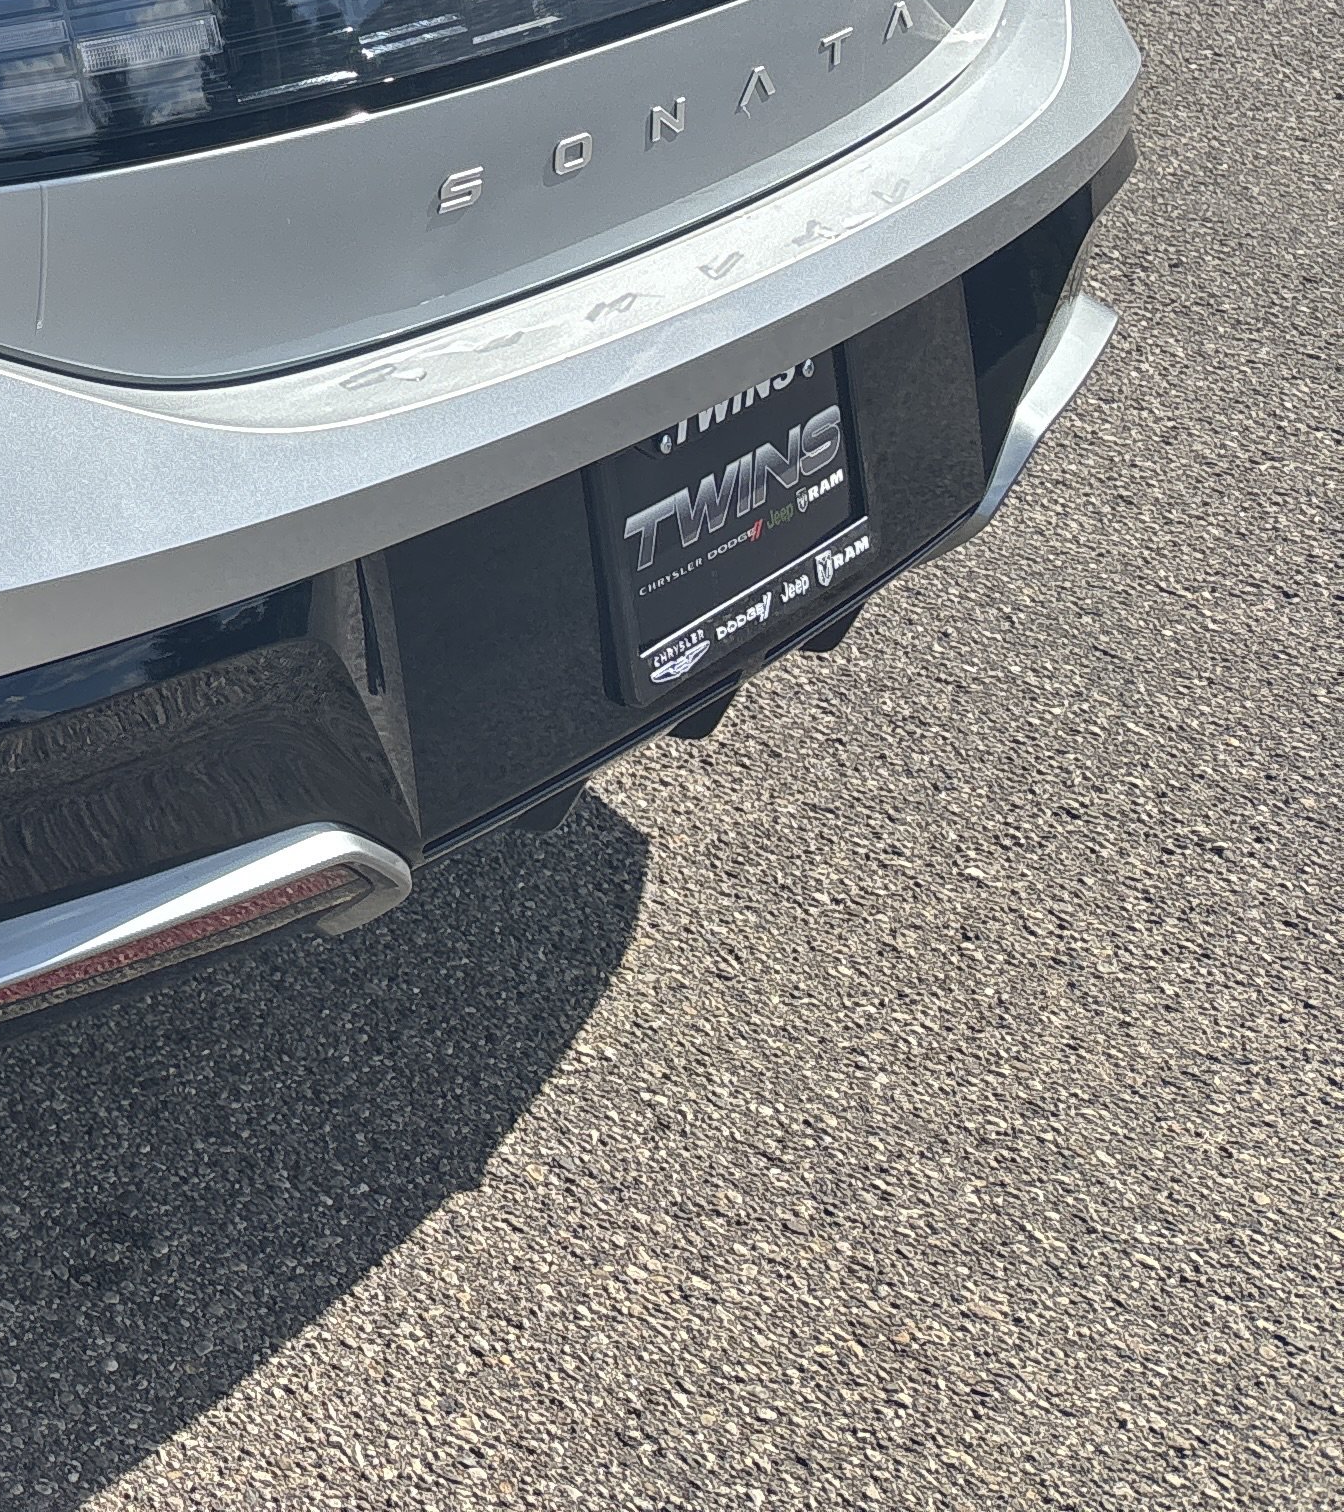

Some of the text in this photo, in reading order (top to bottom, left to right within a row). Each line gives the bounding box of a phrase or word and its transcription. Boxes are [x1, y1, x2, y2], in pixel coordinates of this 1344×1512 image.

[439, 1, 914, 215] SONATA
[624, 405, 841, 572] TWINS
[639, 468, 844, 596] CHRYSLER DODGE Jeep RAM
[653, 535, 870, 668] CHRYSLER DODGE Jeep RAM
